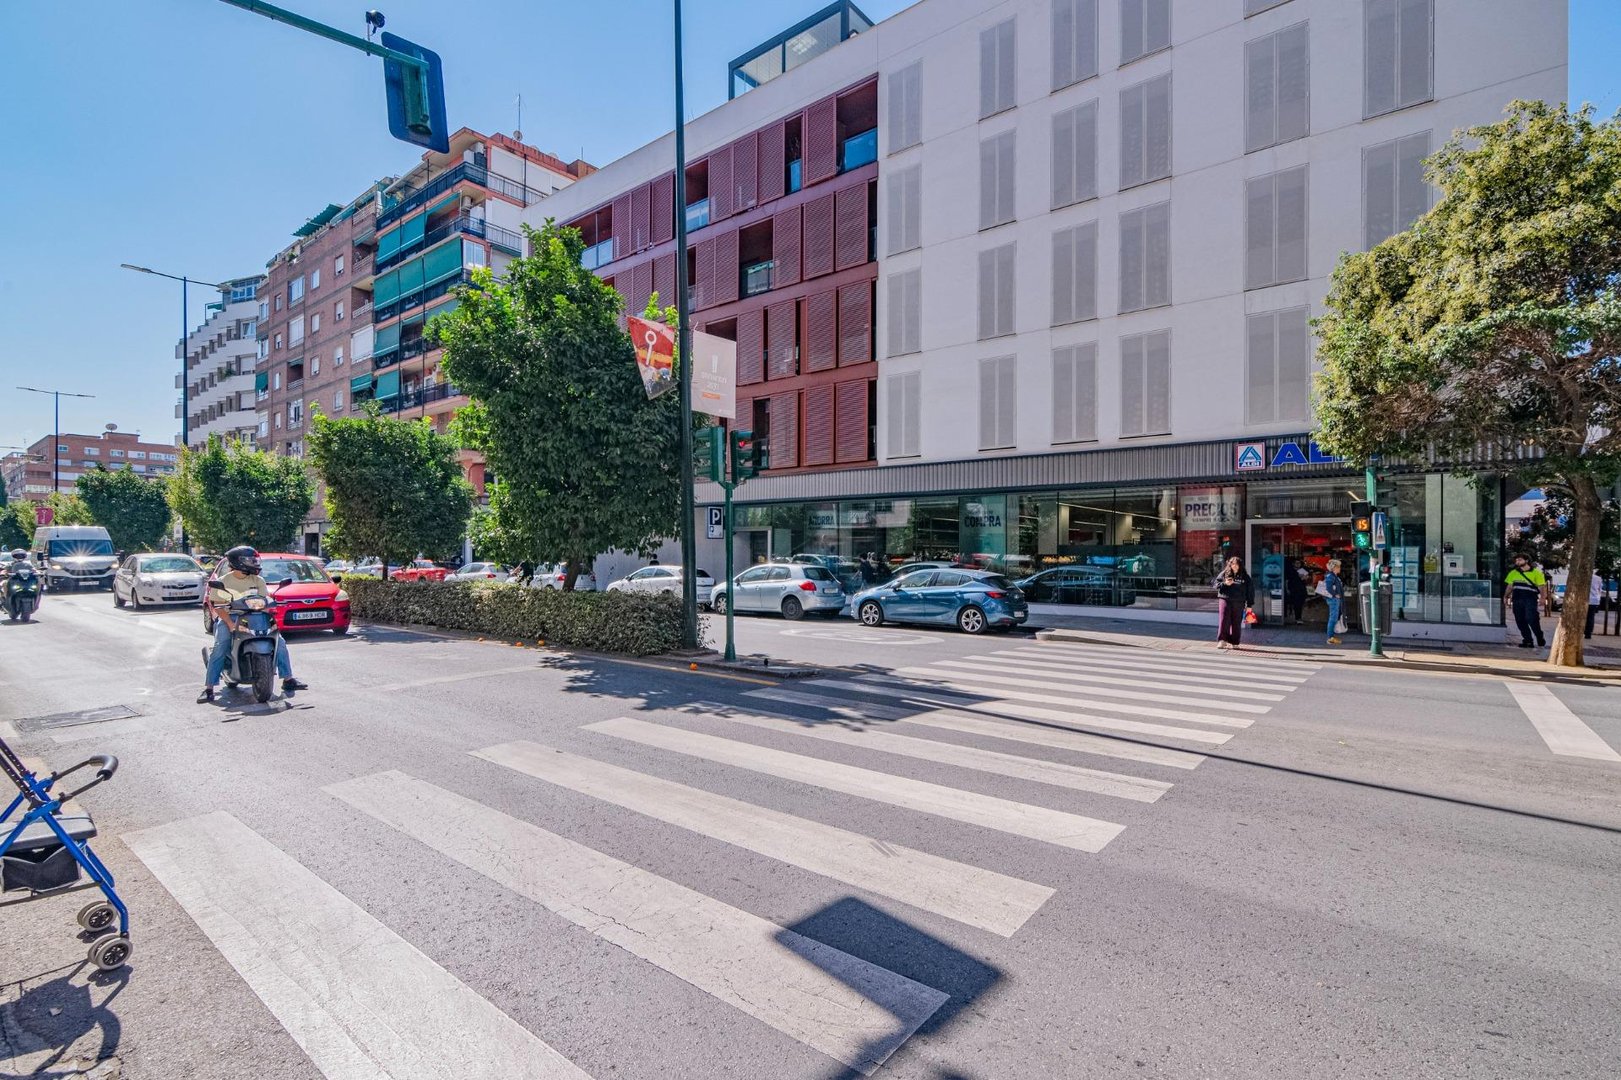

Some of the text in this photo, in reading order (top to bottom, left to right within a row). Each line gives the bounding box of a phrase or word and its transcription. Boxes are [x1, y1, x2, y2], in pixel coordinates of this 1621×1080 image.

[1270, 441, 1379, 466] AL
[1184, 502, 1238, 516] PRECIOS
[712, 509, 721, 525] P
[964, 515, 1002, 527] COMPRA
[1358, 519, 1368, 530] 15
